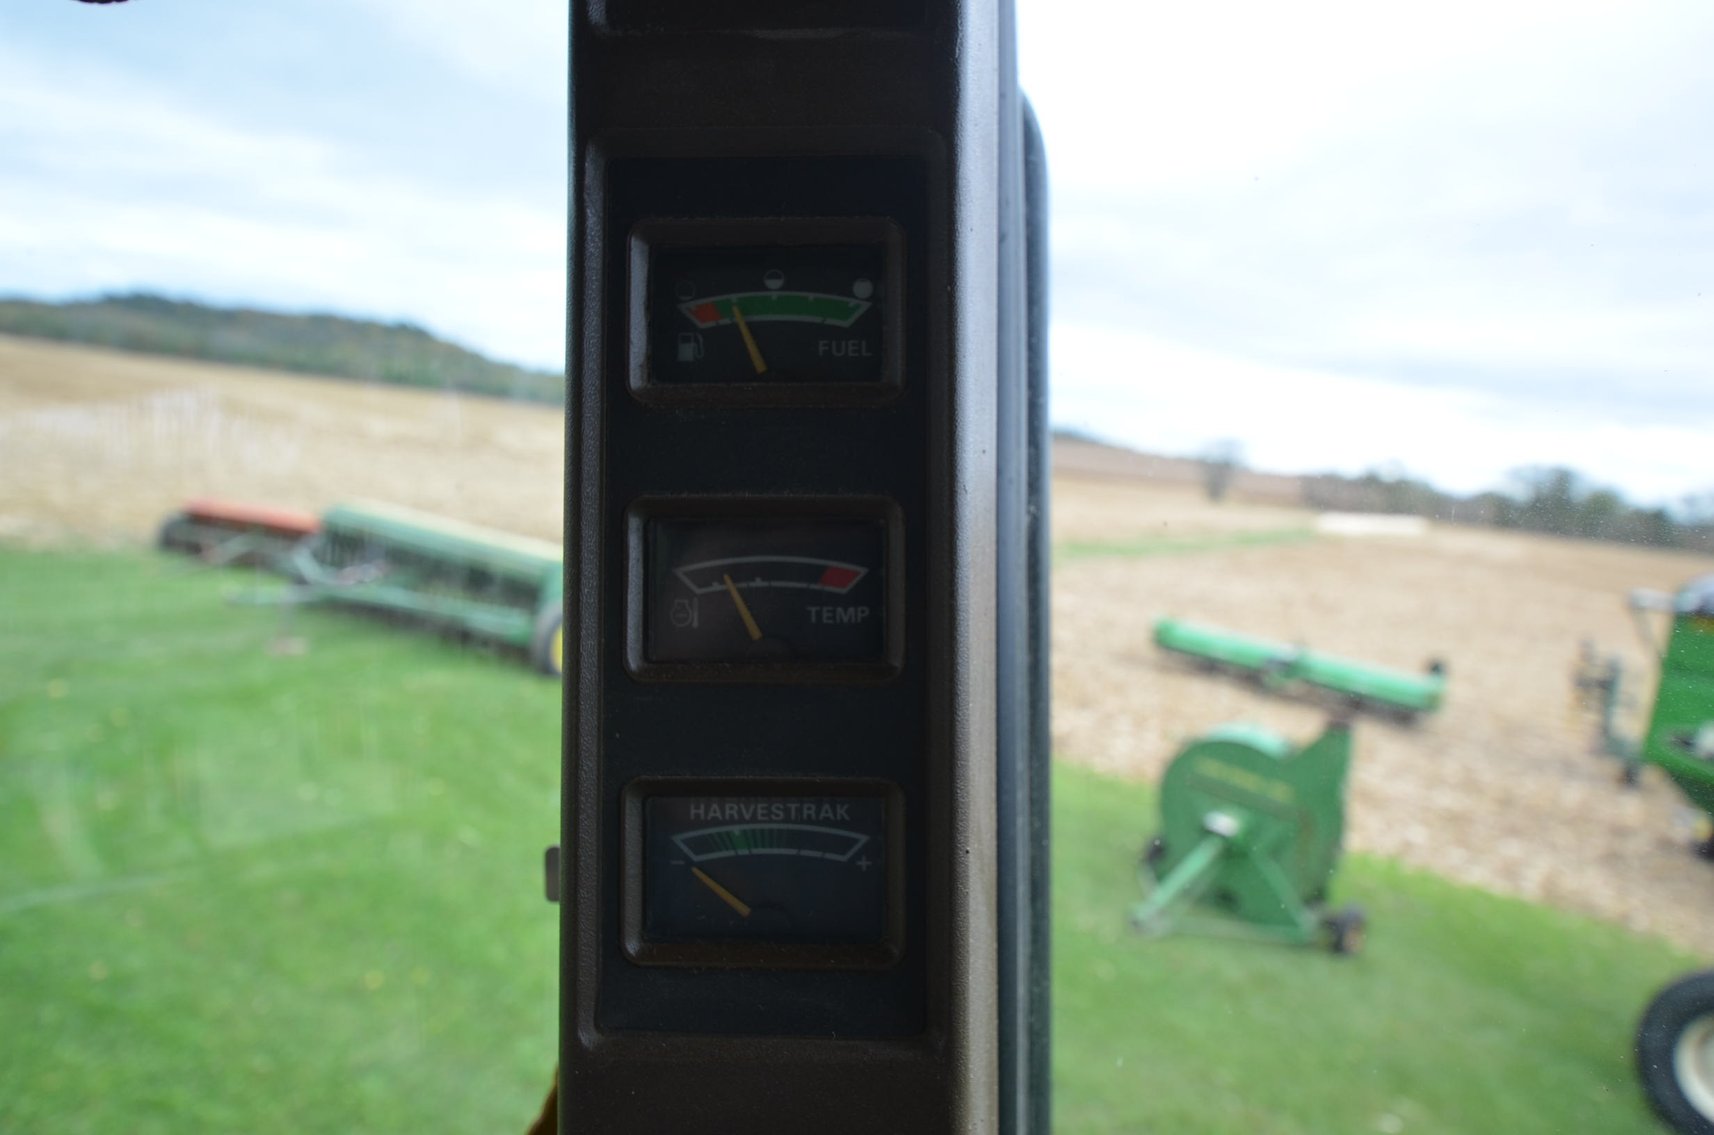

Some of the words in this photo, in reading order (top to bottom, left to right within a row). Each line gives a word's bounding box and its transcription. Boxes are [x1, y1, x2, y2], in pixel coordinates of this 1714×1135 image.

[818, 339, 873, 357] FUEL
[806, 606, 870, 624] TEMP
[690, 803, 851, 821] HARVESTRAK
